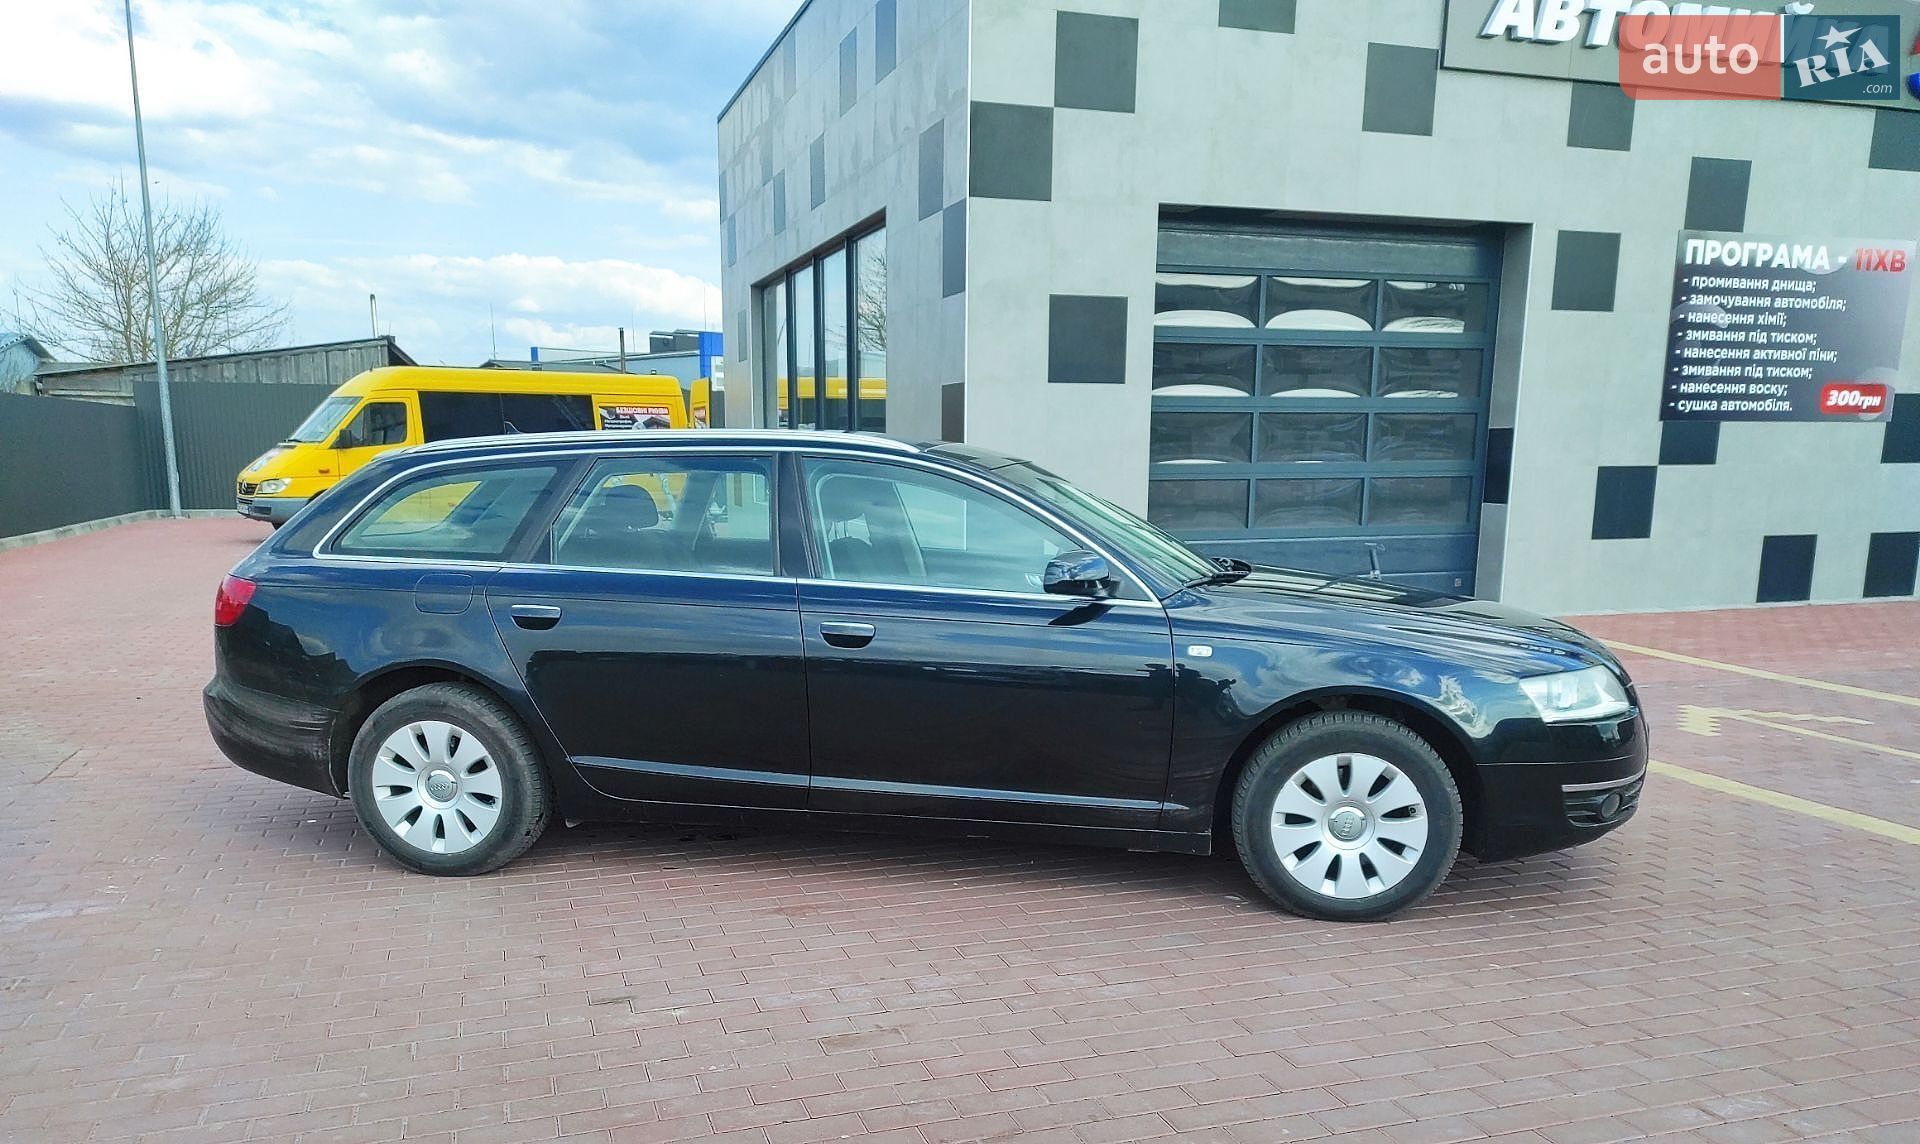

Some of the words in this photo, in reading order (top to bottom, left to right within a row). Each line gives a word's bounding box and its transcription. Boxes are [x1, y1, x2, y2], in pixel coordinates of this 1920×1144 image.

[1685, 239, 1830, 270] ПРОГРАМА
[1855, 248, 1907, 273] 11ХВ
[1691, 276, 1769, 291] промивання
[1772, 280, 1816, 293] днища;
[1690, 294, 1771, 312] замочування
[1774, 295, 1847, 312] автомобіля;
[1688, 312, 1754, 325] нанесення
[1758, 313, 1787, 327] хімії;
[1686, 330, 1745, 342] змивання
[1749, 329, 1767, 343] під
[1771, 332, 1817, 345] тиском;
[1684, 348, 1750, 360] нанесення
[1753, 349, 1807, 360] активної
[1809, 349, 1838, 363] піни;
[1682, 365, 1741, 377] змивання
[1745, 364, 1763, 378] під
[1767, 367, 1813, 380] тиском;
[1680, 383, 1746, 394] нанесення
[1749, 384, 1788, 397] воску;
[1678, 400, 1718, 413] сушка
[1721, 400, 1792, 412] автомобіля.
[1826, 390, 1882, 409] 300грн
